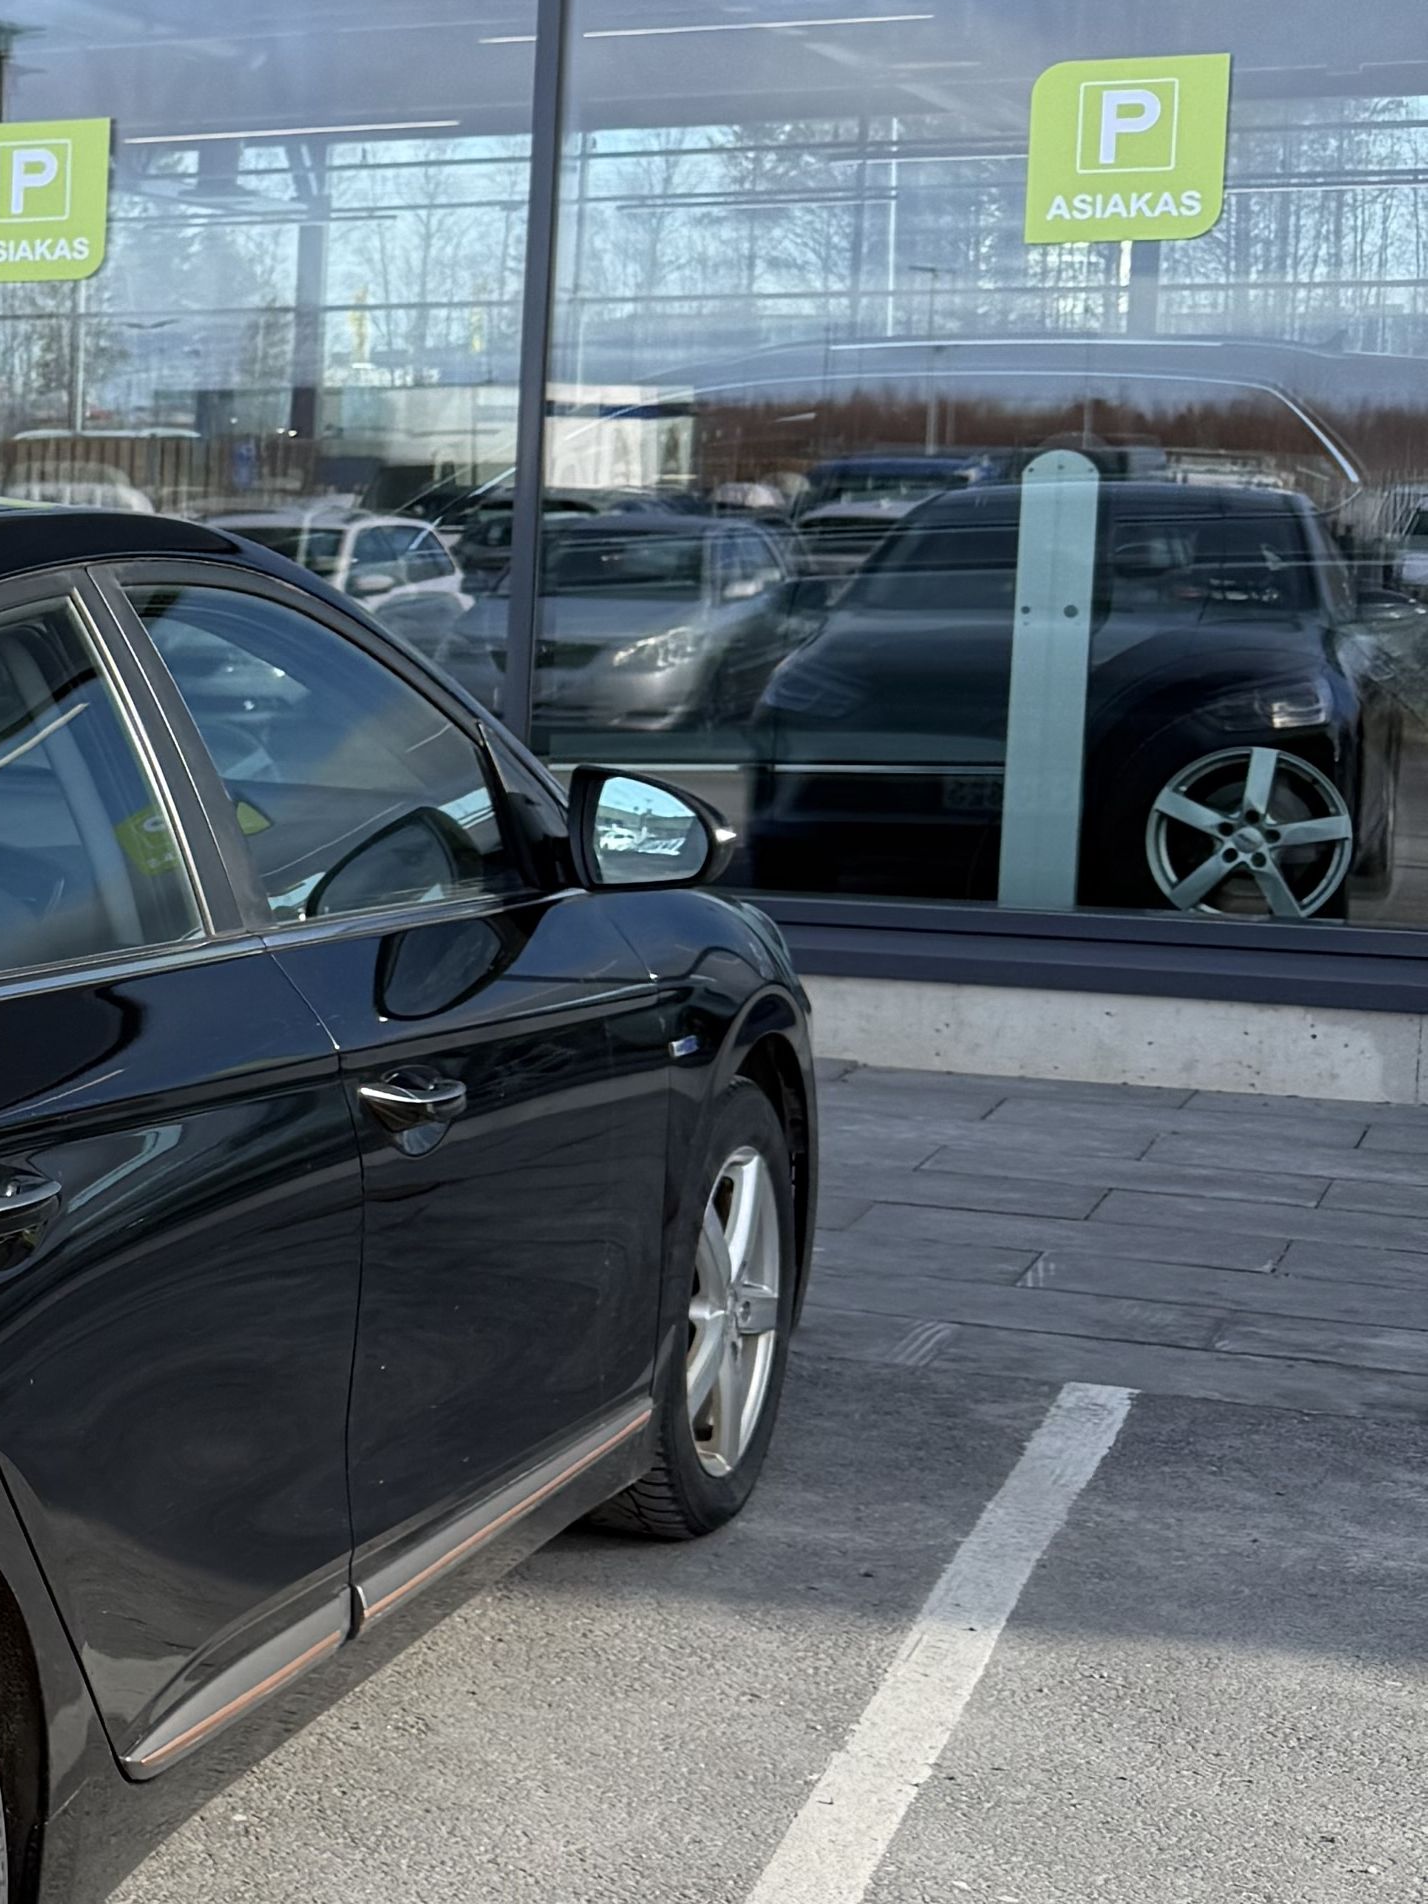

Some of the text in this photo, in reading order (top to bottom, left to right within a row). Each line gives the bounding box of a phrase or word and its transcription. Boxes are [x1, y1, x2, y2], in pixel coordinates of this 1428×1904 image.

[1098, 89, 1162, 164] P
[11, 149, 58, 214] P
[1046, 189, 1202, 221] ASIAKAS
